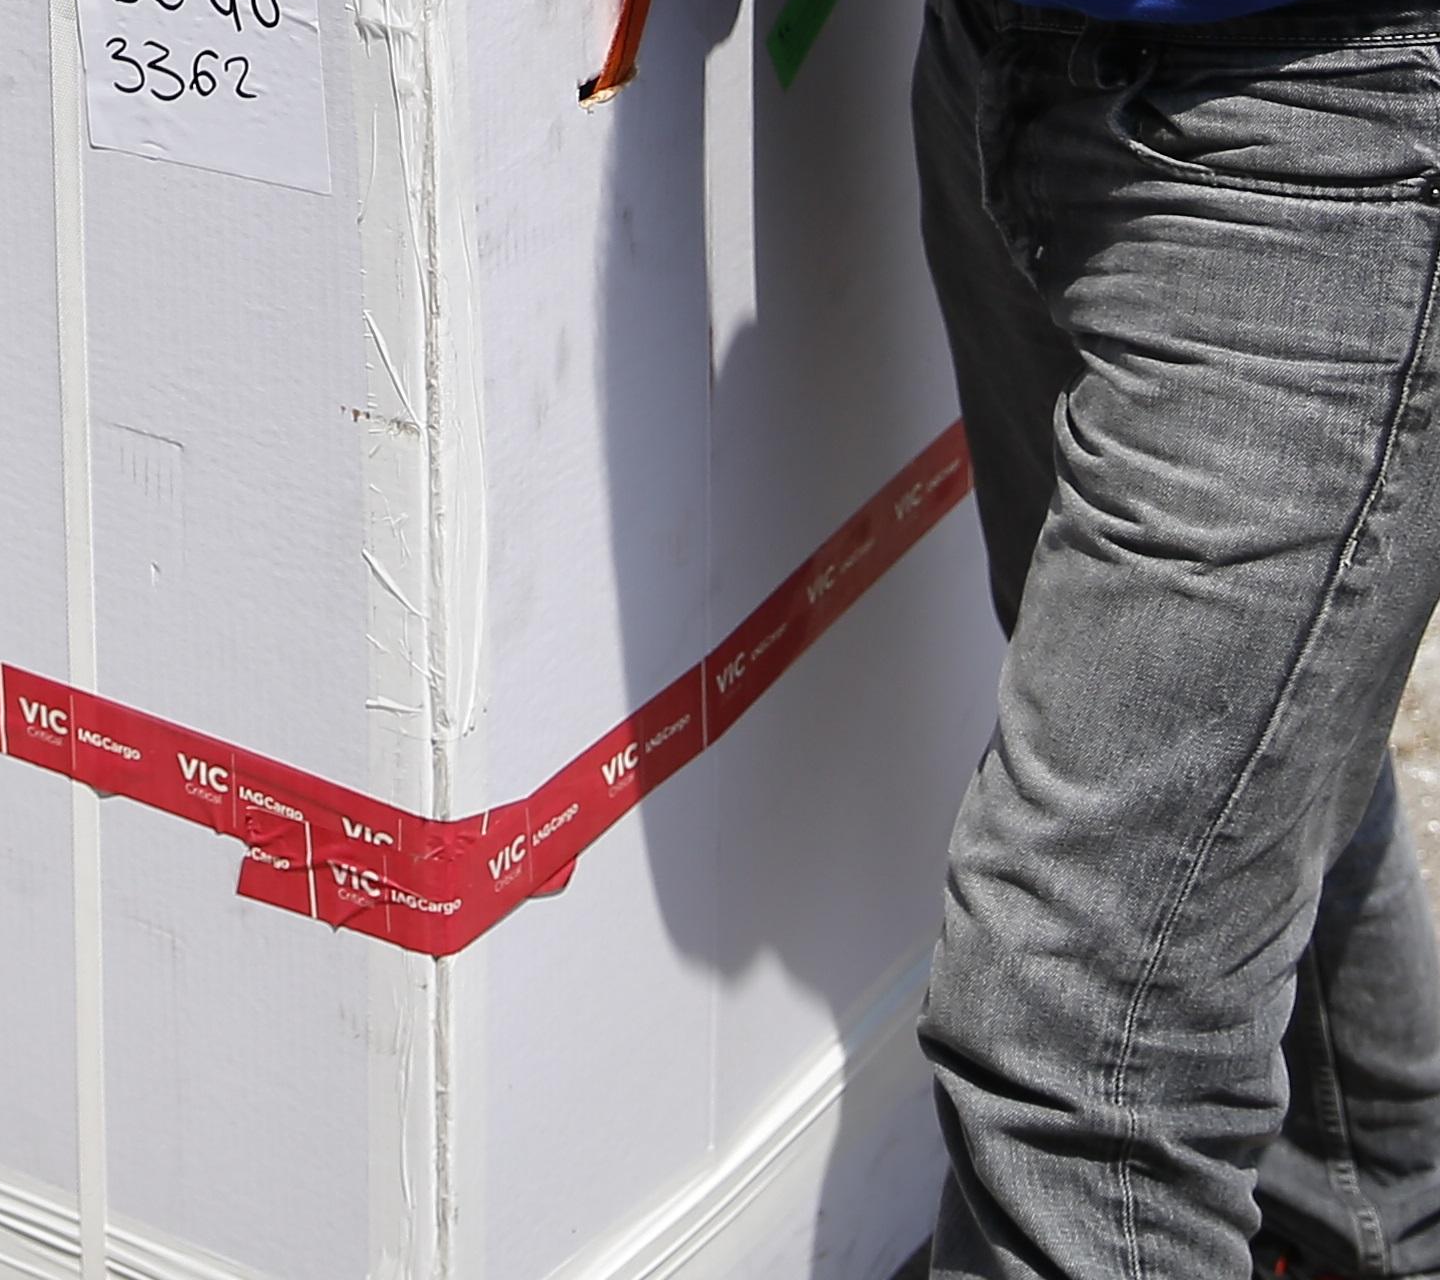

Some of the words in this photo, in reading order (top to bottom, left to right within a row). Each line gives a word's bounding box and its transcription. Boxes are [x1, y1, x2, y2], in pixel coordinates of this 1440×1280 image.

[105, 35, 258, 102] 3362
[715, 650, 746, 694] VIC
[18, 696, 69, 736] VIC
[176, 752, 229, 793] VIC
[601, 741, 640, 786] VIC
[326, 859, 381, 897] VIC
[487, 834, 527, 880] VIC
